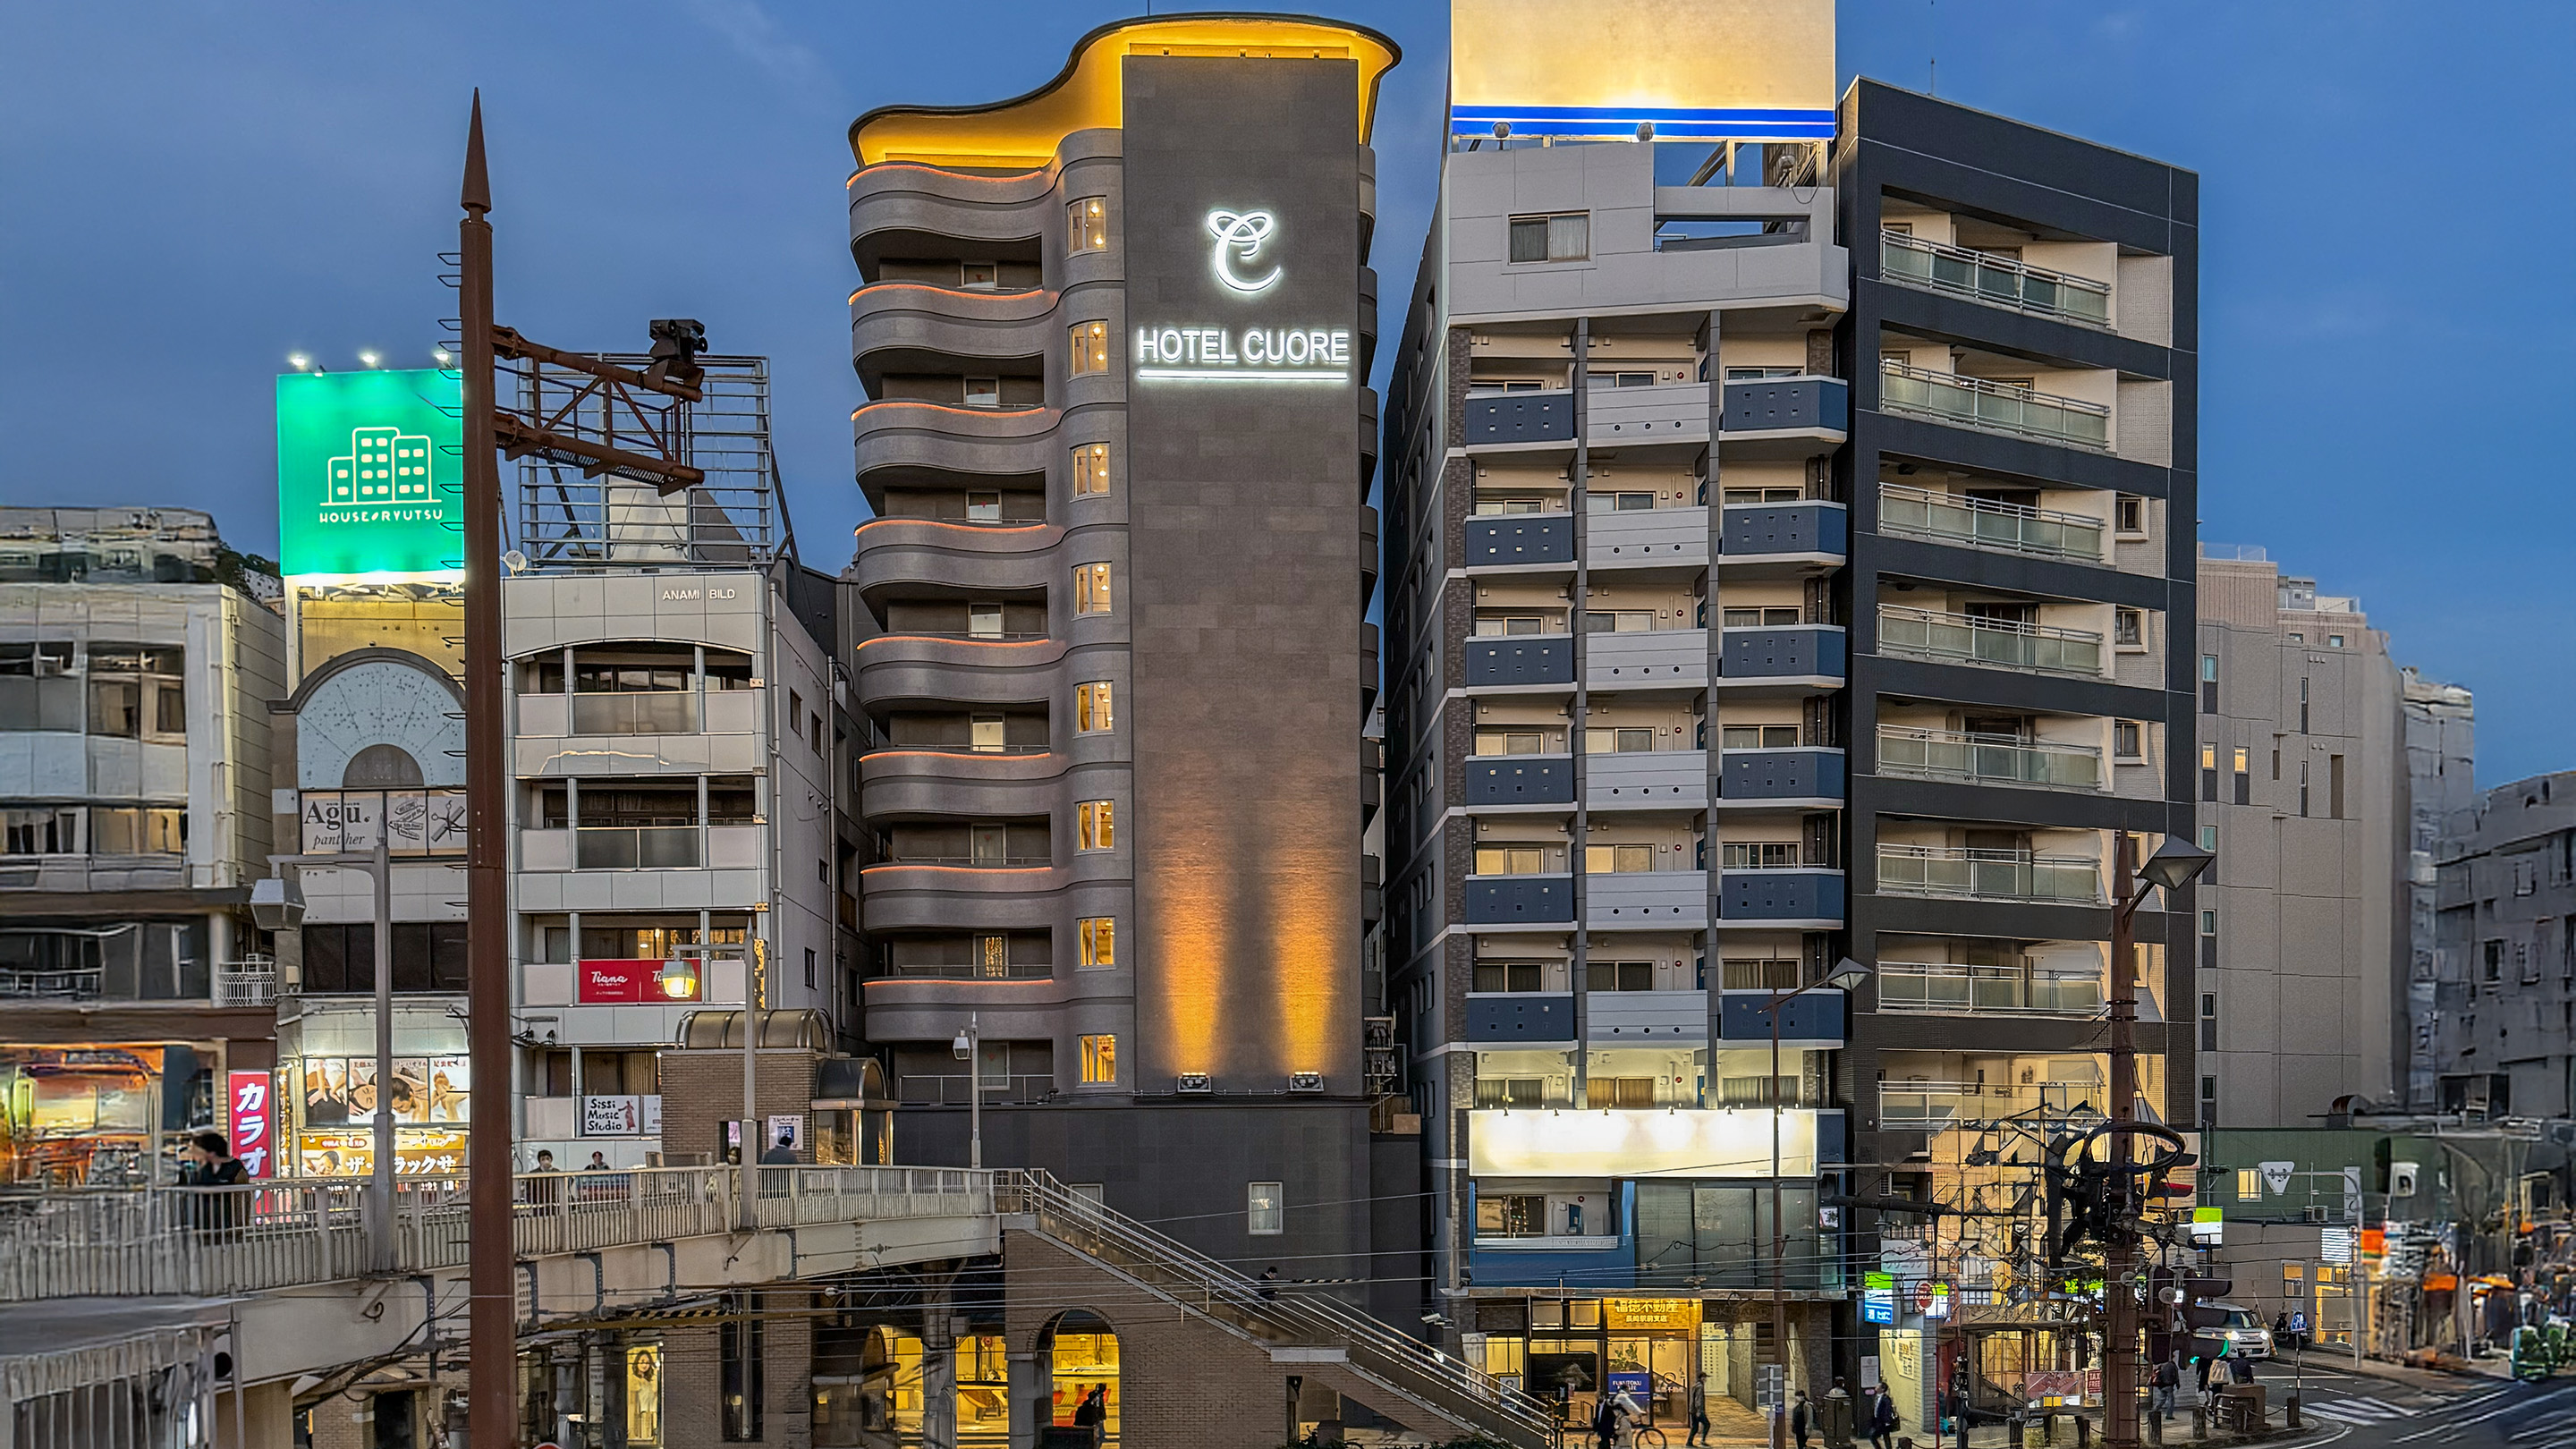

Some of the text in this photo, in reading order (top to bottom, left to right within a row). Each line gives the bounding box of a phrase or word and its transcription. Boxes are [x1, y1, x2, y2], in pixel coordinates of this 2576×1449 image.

[1139, 329, 1349, 362] HOTEL CUORE
[663, 589, 735, 600] ANAMI BILD
[591, 970, 628, 984] Tiana
[590, 1098, 615, 1109] Sissi
[588, 1110, 620, 1119] Music
[588, 1120, 623, 1131] Studio
[236, 1082, 267, 1201] カラオ
[2089, 1372, 2100, 1380] TAX
